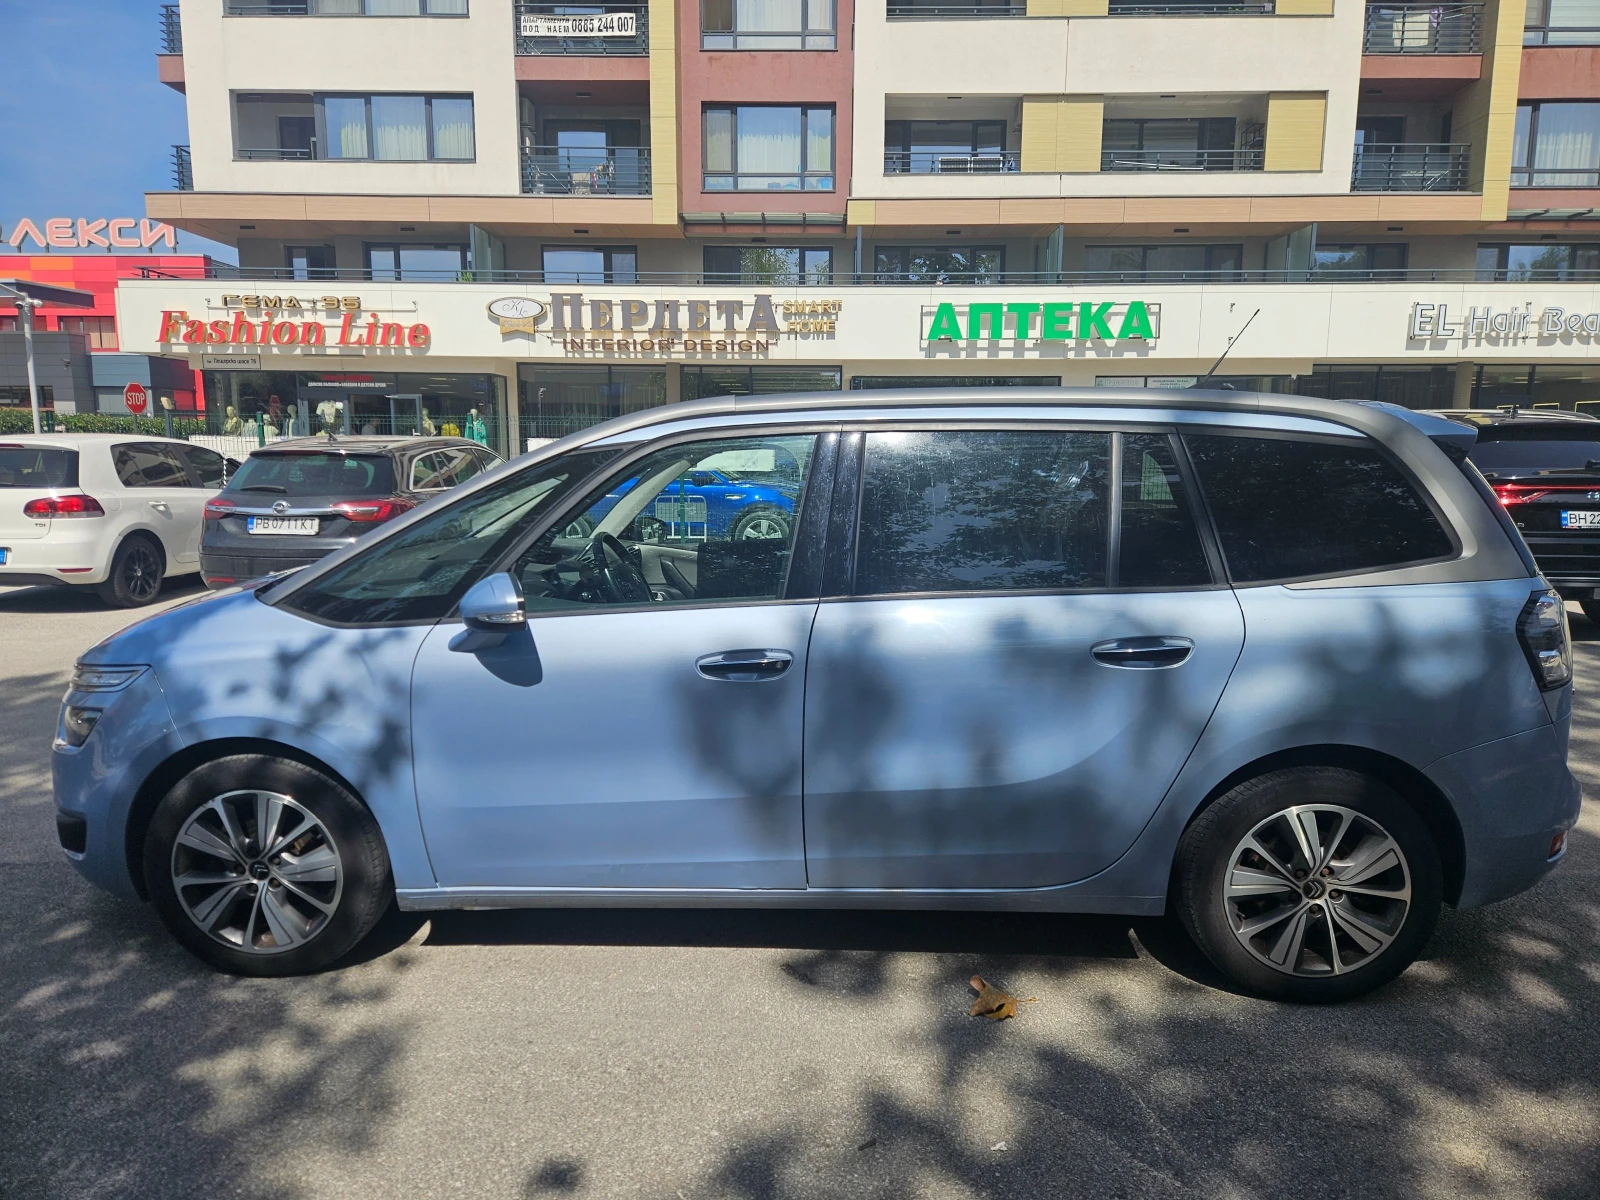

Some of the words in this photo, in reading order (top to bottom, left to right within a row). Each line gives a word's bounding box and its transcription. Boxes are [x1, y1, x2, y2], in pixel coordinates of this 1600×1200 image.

[522, 25, 540, 34] ПОД
[547, 25, 570, 33] НАЕМ
[571, 18, 594, 33] 0885
[597, 17, 615, 32] 244
[617, 16, 634, 32] 007
[221, 294, 302, 309] ГЕМА
[321, 296, 361, 310] 96
[783, 299, 843, 314] SMART
[787, 319, 837, 332] HOME
[927, 300, 1154, 341] АПТЕКА
[1413, 303, 1455, 337] EL
[1469, 306, 1531, 336] Hair
[155, 310, 326, 346] Fashion
[336, 312, 430, 348] Line
[562, 338, 672, 351] INTERIOR
[684, 339, 770, 352] DESIGN
[127, 392, 145, 406] STOP
[1569, 513, 1587, 525] BH
